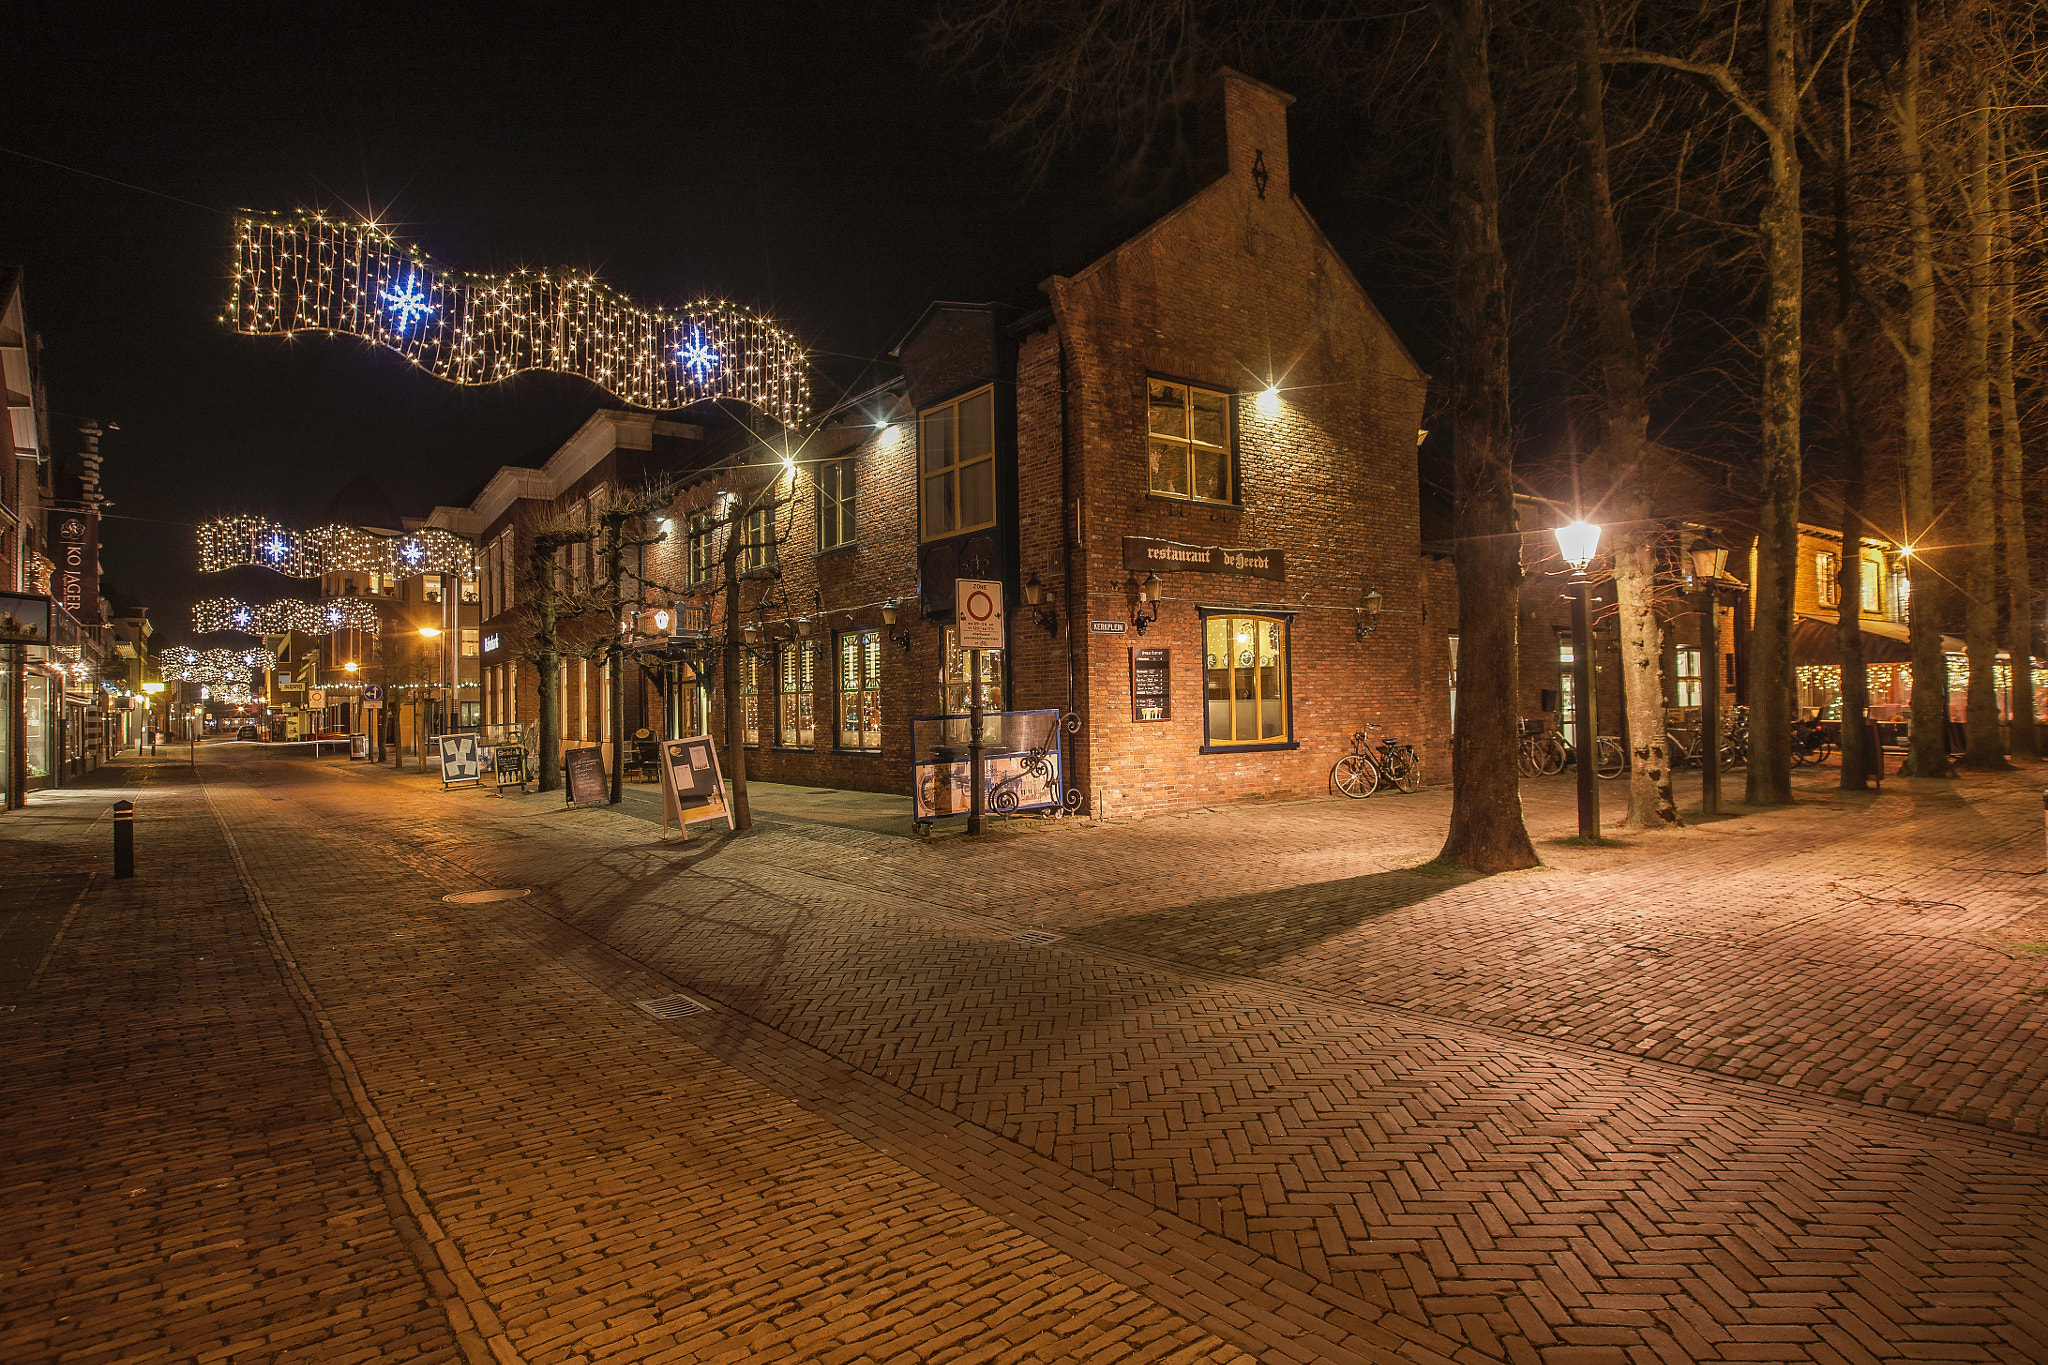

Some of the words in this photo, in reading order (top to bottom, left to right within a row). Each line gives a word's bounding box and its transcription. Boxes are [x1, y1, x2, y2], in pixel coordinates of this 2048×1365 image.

[67, 546, 81, 566] KO
[1147, 546, 1211, 563] restaurant
[64, 570, 81, 611] JAGER
[972, 583, 987, 591] ZONE
